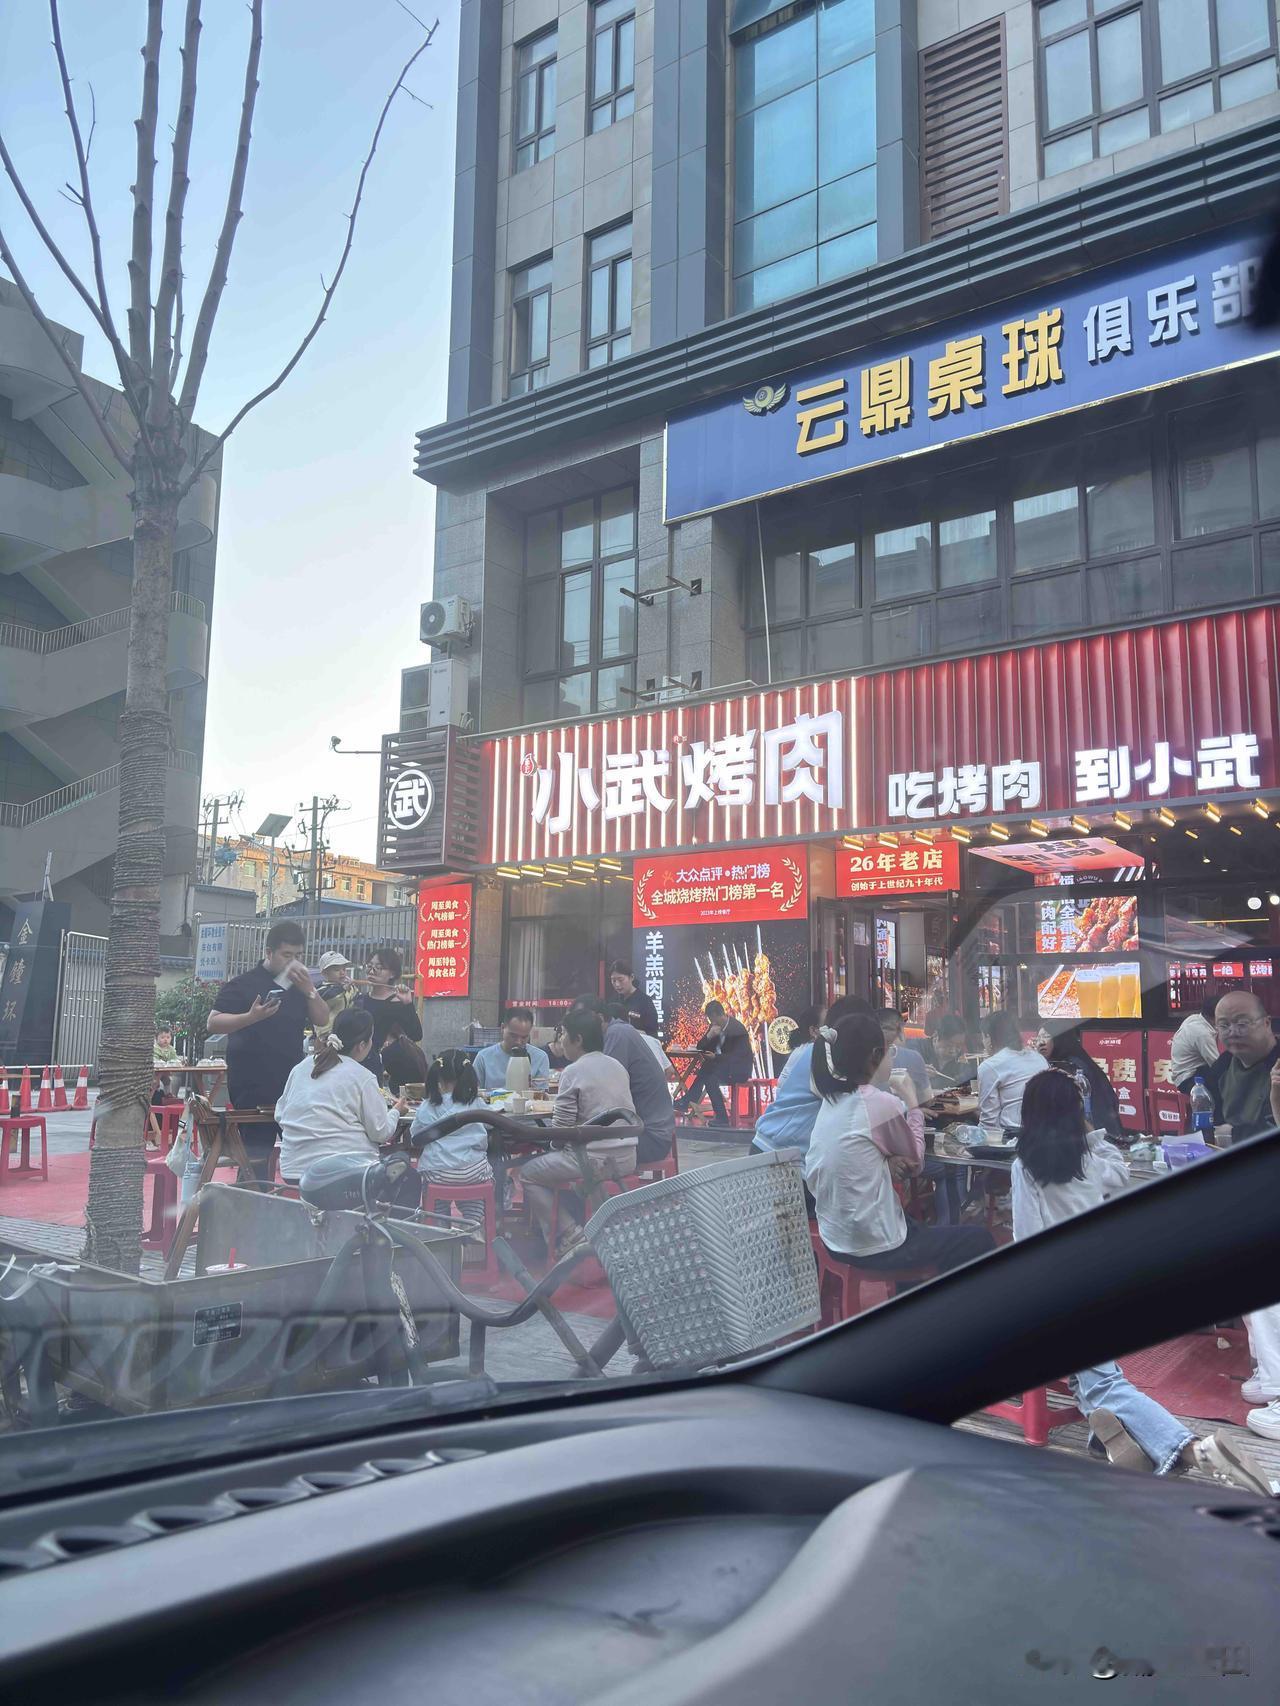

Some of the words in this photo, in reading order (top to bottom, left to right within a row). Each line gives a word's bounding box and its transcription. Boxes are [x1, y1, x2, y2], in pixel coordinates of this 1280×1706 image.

[531, 711, 844, 834] 小武烤肉
[888, 759, 1041, 819] 吃烤肉
[1075, 733, 1260, 802] 到小武
[393, 778, 426, 818] 武
[850, 848, 943, 872] 26年老店
[651, 881, 784, 906] 全城烧烤热门榜第一名
[851, 876, 943, 892] 创始于上世纪九十年代
[427, 911, 462, 921] 人气榜第一
[427, 968, 456, 978] 美食名店
